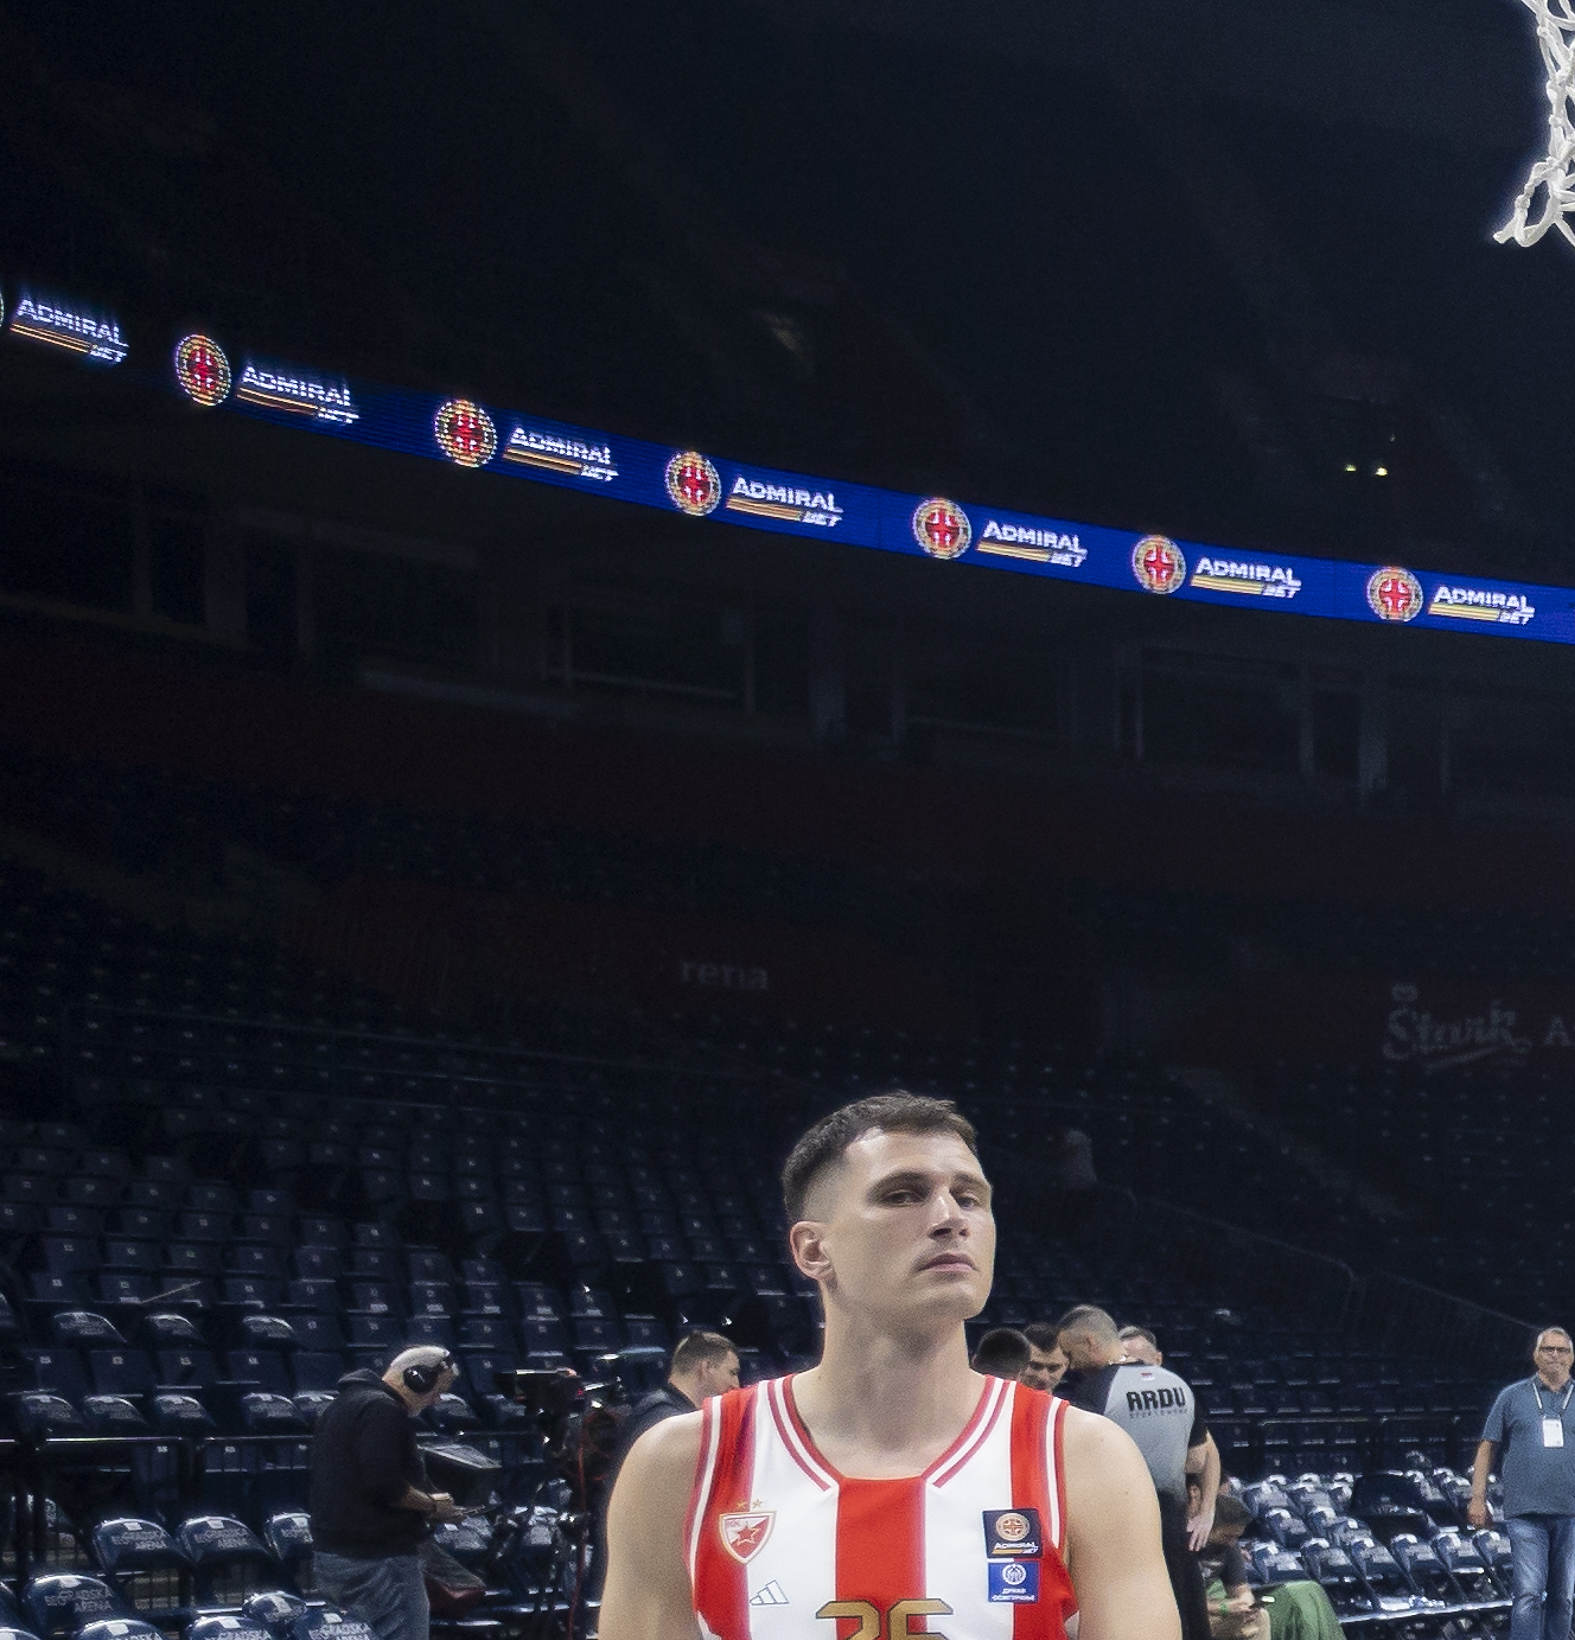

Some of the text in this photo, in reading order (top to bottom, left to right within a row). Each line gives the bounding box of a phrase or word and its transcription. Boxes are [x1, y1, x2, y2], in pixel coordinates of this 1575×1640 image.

[16, 299, 129, 347] ADMIRAL
[242, 366, 352, 406] ADMIRAL
[511, 427, 612, 464] ADMIRAL
[733, 477, 844, 513] ADMIRAL
[983, 520, 1084, 553] ADMIRAL
[1050, 549, 1087, 568] BET
[1196, 557, 1301, 585] ADMIRAL
[1261, 582, 1300, 599] BET
[1434, 586, 1534, 613] ADMIRAL
[1499, 608, 1535, 626] BET
[1126, 1387, 1186, 1411] ARDU
